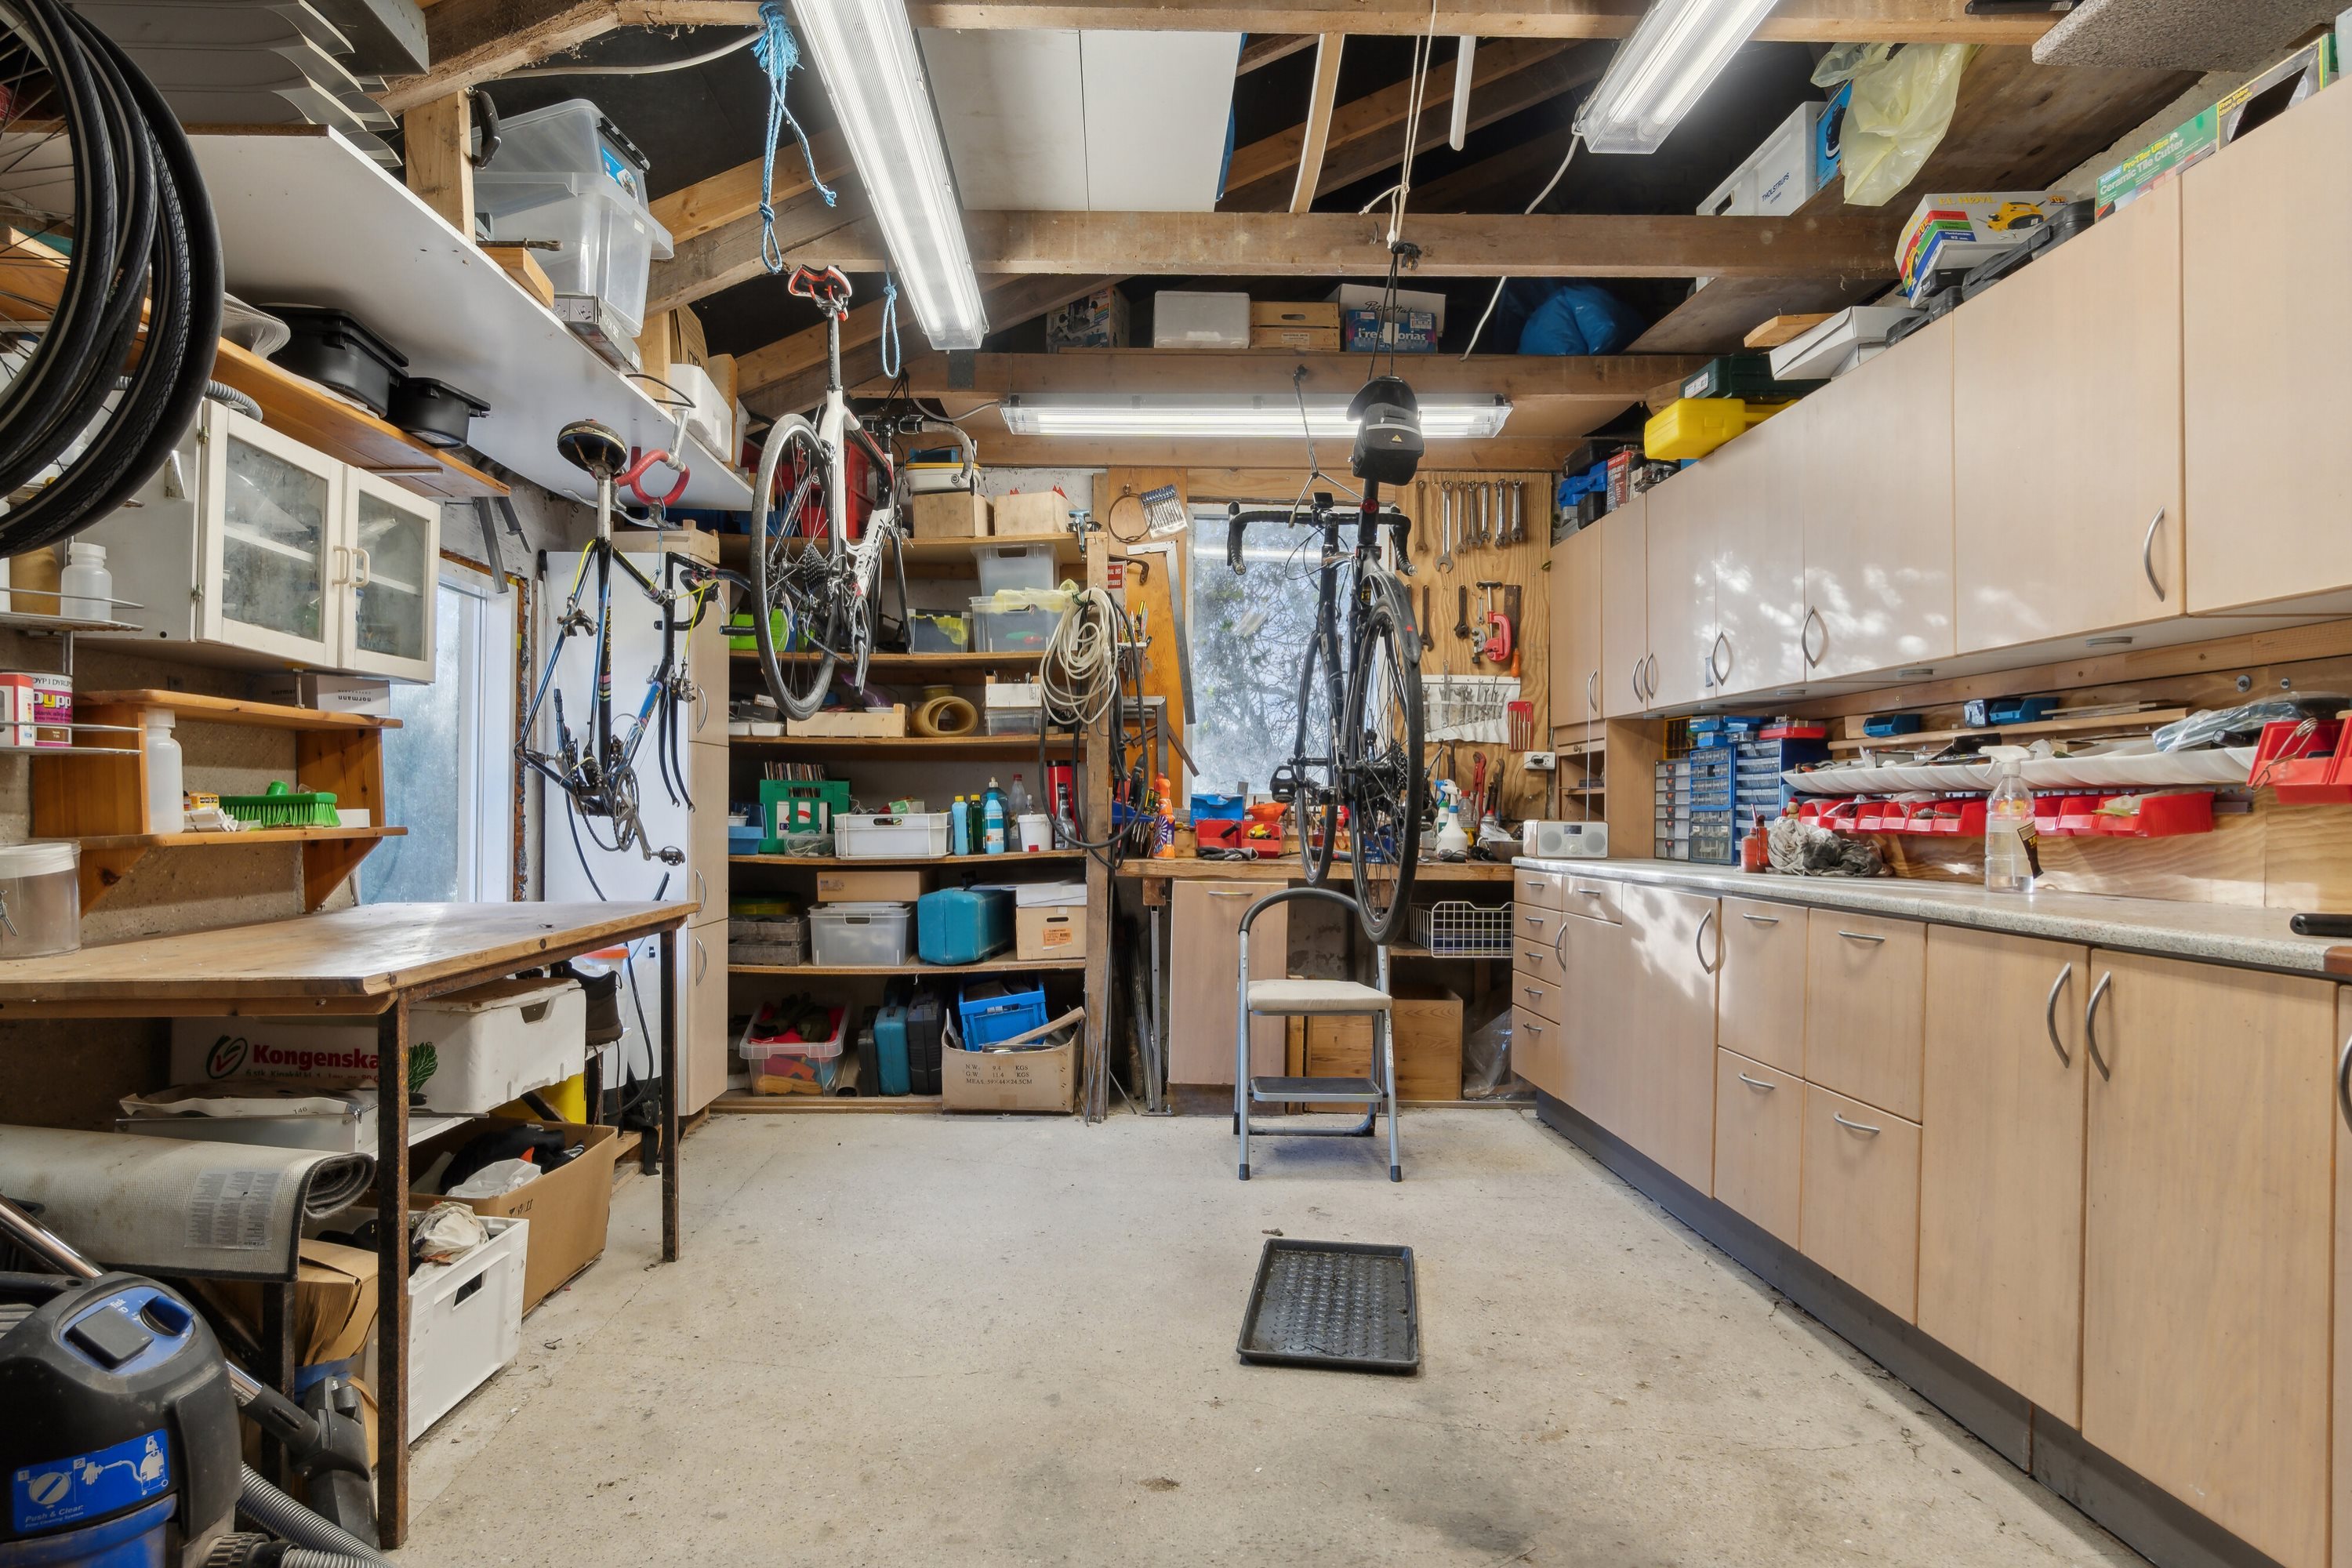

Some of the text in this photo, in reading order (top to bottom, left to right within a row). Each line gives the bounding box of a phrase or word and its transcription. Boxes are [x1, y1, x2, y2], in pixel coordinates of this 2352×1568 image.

[2100, 168, 2137, 195] Ceramic
[2136, 157, 2154, 172] Tile
[2154, 138, 2185, 162] Cutter
[26, 1513, 47, 1523] Push
[49, 1509, 56, 1518] &
